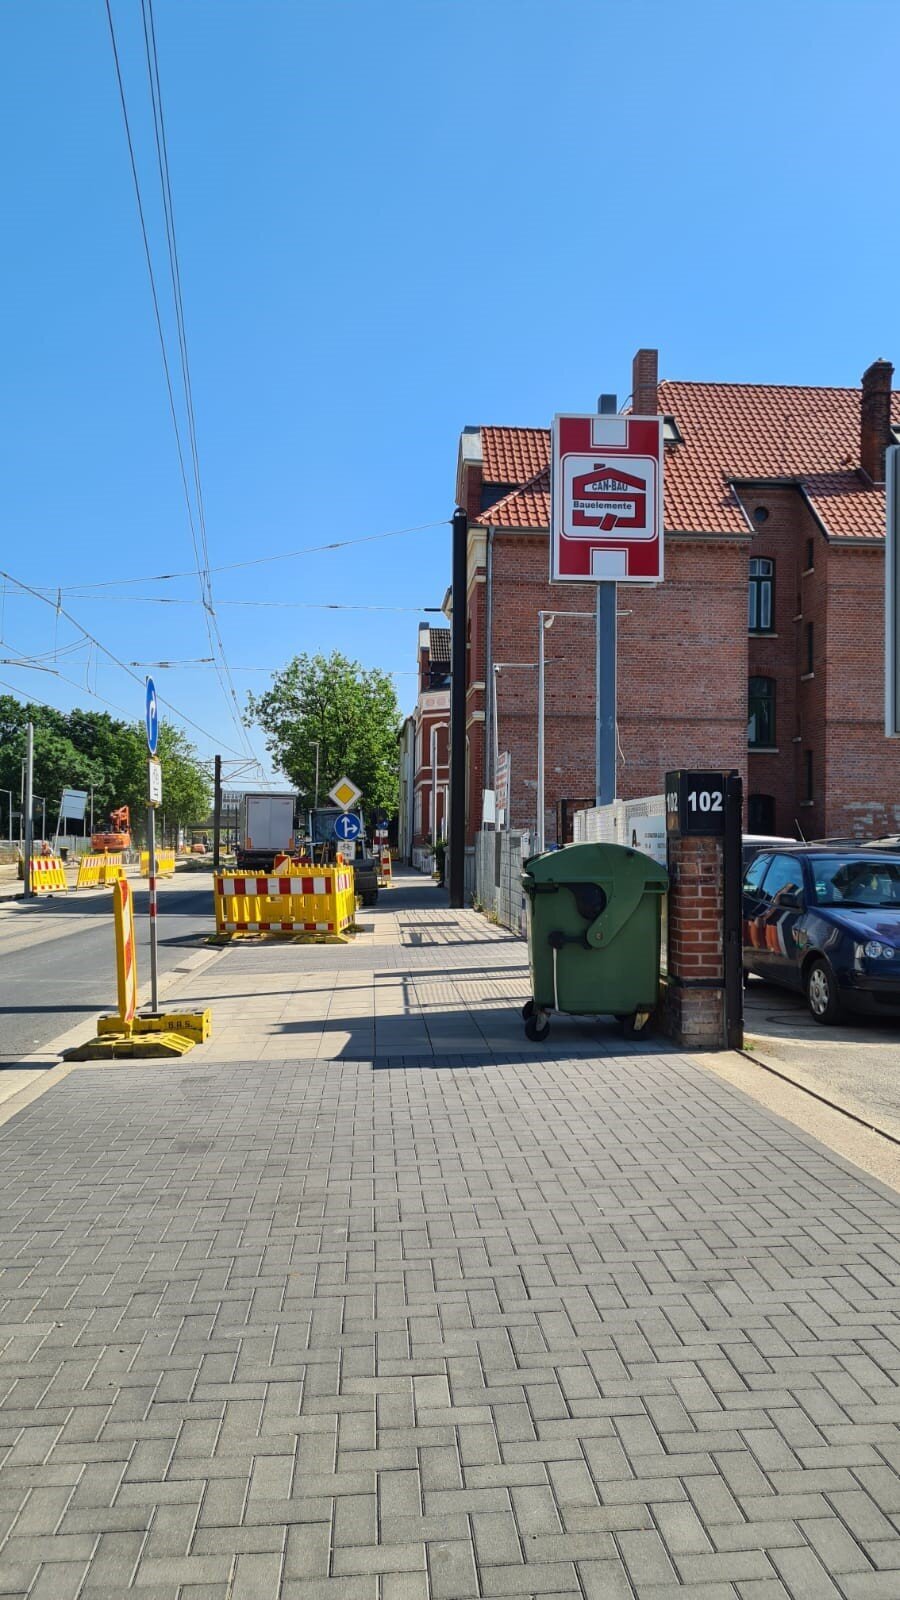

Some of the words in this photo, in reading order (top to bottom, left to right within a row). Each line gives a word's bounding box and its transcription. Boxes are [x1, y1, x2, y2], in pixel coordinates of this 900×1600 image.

[592, 480, 628, 491] CAN-BAU
[573, 501, 632, 510] Bauelemente
[688, 791, 723, 812] 102
